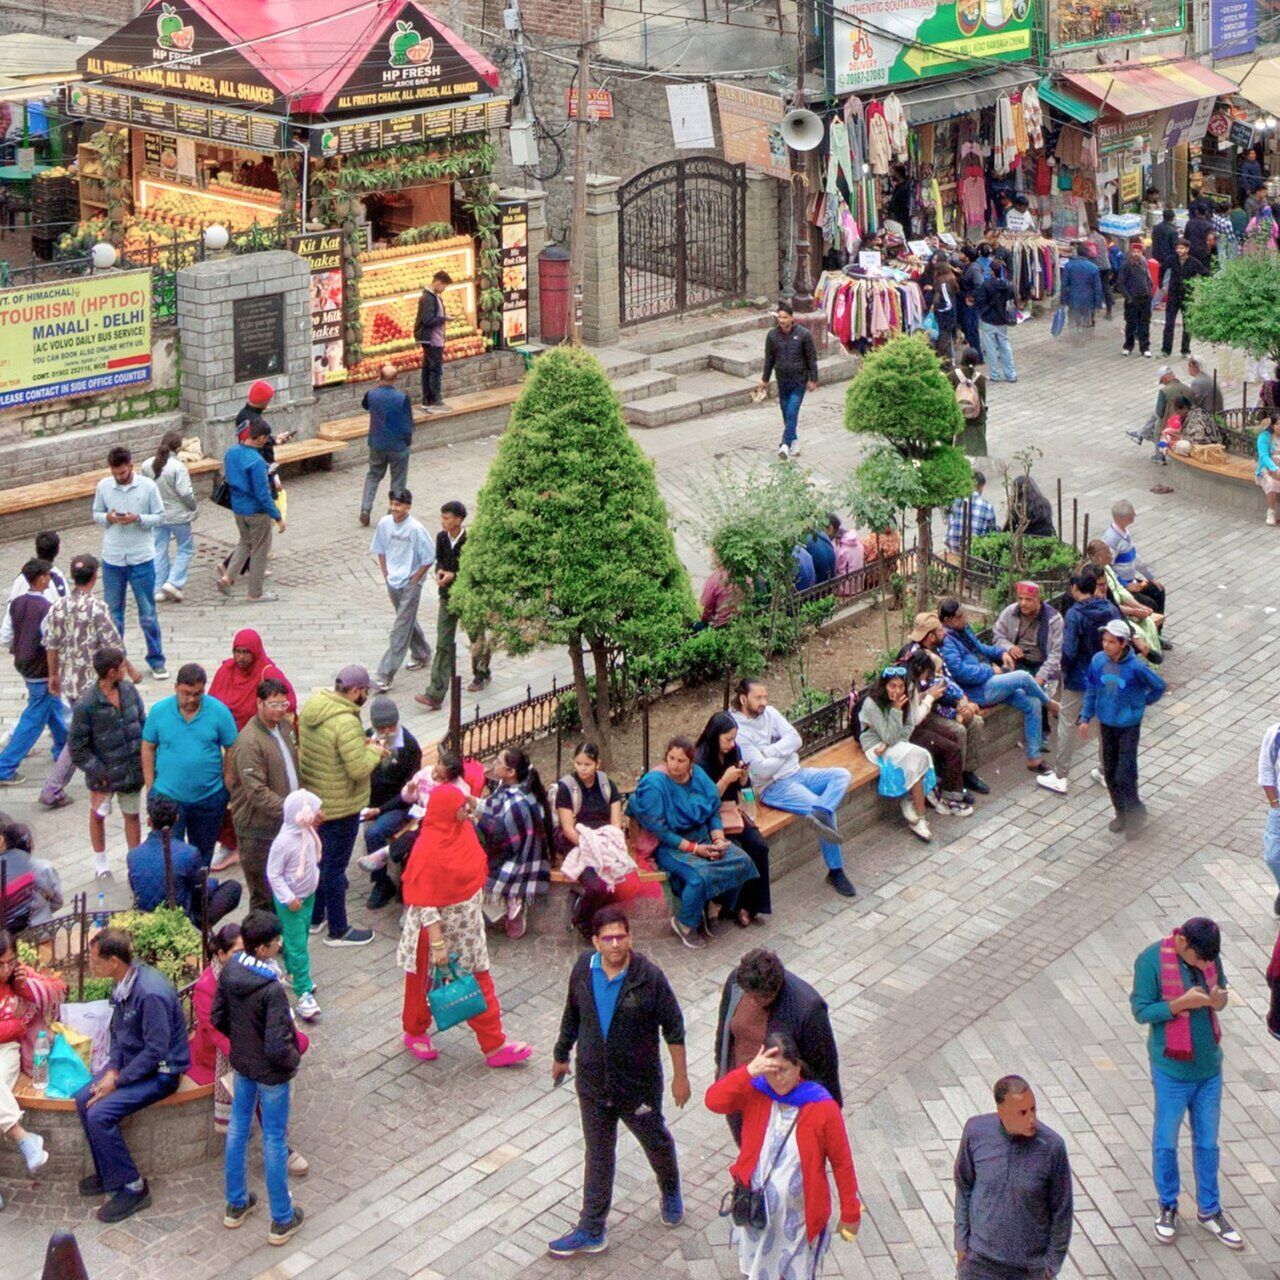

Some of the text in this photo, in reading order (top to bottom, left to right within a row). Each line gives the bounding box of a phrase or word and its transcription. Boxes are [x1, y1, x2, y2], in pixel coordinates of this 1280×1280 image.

[884, 0, 910, 12] SOUTH
[153, 49, 201, 65] HP FRESH
[848, 59, 877, 71] DELIVERY
[87, 58, 274, 104] ALL FRUITS CHAAT, ALL JUICES, ALL SHAKES
[382, 65, 441, 81] HP FRESH
[394, 79, 414, 87] JUICE
[338, 81, 478, 108] ALL FRUITS CHAAT, ALL JUICES, ALL SHAKES
[298, 236, 340, 253] Kit Kat
[12, 295, 25, 304] OF
[26, 287, 76, 303] HIMACHAL)
[0, 301, 76, 325] TOURISM
[81, 290, 146, 317] (HPTDC)
[33, 319, 89, 340] MANALI
[103, 309, 145, 329] DELHI
[49, 337, 74, 352] VOLVO
[75, 334, 96, 348] DAILY
[98, 331, 112, 343] BUS
[113, 326, 145, 341] SERVICE)
[33, 356, 45, 365] YOU
[46, 353, 58, 363] CAN
[61, 350, 77, 360] BOOK
[79, 347, 95, 357] ALSO
[96, 344, 117, 355] ONLINE
[119, 341, 133, 351] WITH
[25, 386, 59, 401] CONTACT
[60, 383, 68, 394] IN
[69, 380, 86, 392] SIDE
[87, 375, 114, 389] OFFICE
[116, 369, 147, 384] COUNTER
